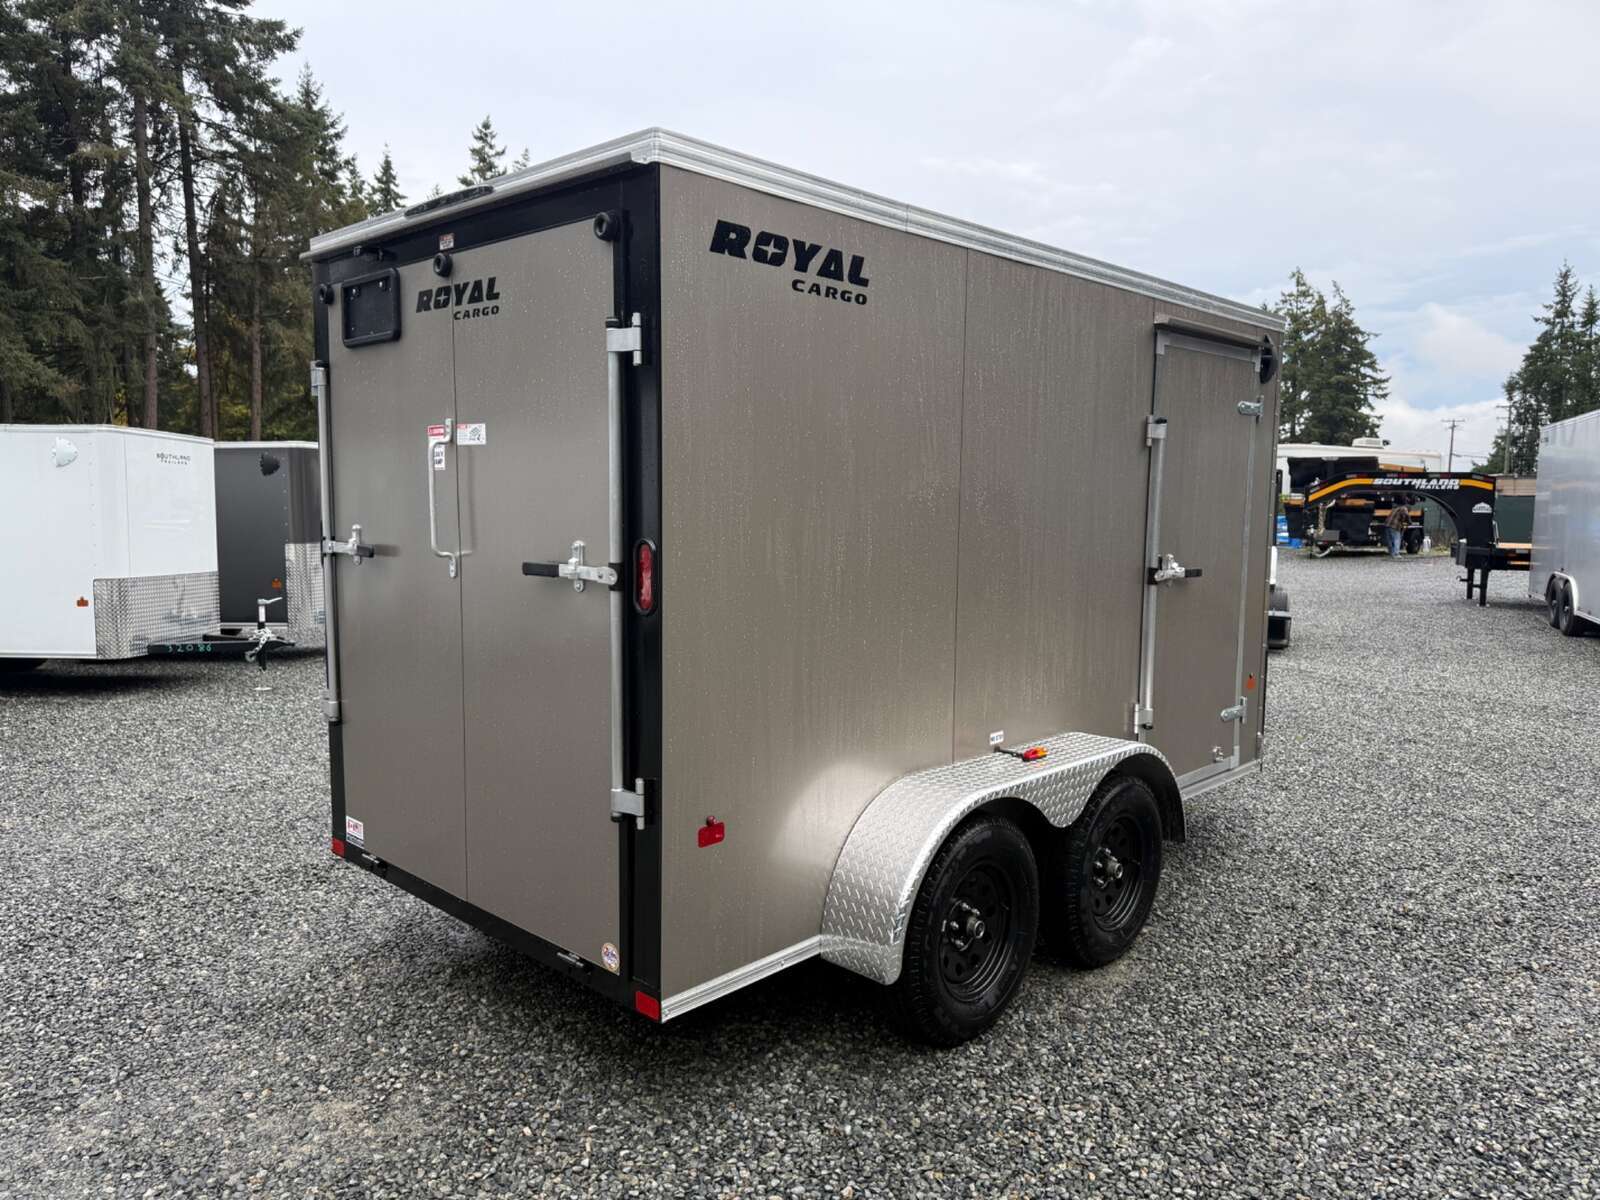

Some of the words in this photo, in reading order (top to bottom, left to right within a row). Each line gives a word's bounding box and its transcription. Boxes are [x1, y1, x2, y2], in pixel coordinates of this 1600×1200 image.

[709, 219, 870, 288] ROYAL
[416, 276, 500, 313] ROYAL
[791, 279, 868, 305] CARGO
[453, 305, 500, 321] CARGO
[1372, 478, 1460, 486] SOUTHLAND
